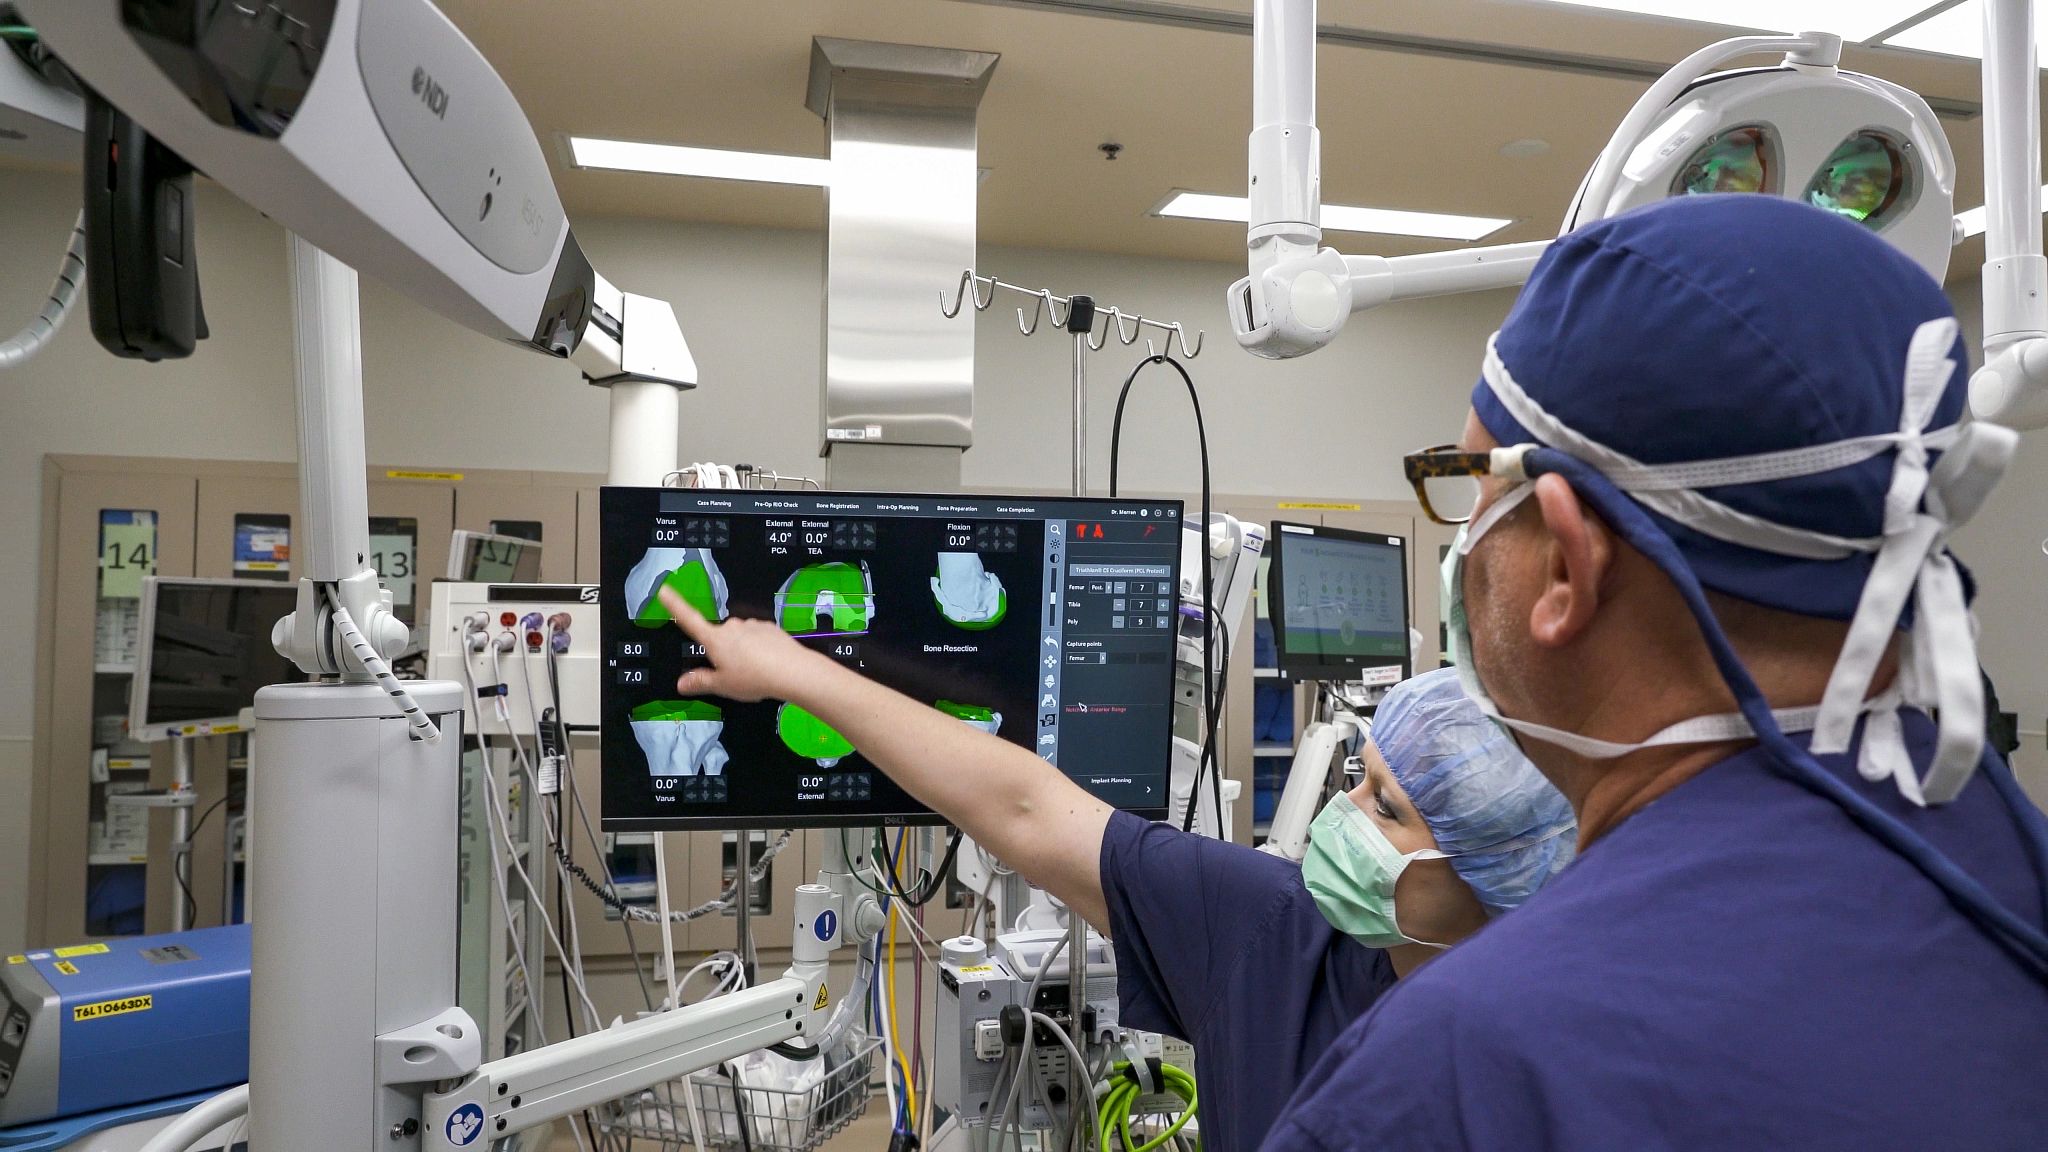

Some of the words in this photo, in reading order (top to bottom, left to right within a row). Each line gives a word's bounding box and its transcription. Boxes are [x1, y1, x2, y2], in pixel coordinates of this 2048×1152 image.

[765, 520, 794, 528] External
[801, 520, 829, 528] External
[947, 523, 971, 531] Flexion
[808, 547, 822, 555] TEA
[108, 542, 150, 570] 14
[372, 551, 409, 578] 13
[1139, 601, 1144, 609] 7
[1067, 618, 1079, 626] Poly
[1138, 618, 1143, 626] 9
[624, 645, 642, 655] 8.0
[689, 645, 706, 655] 1.0
[835, 645, 853, 655] 4.0
[624, 671, 642, 682] 7.0
[1091, 777, 1110, 785] Implant
[797, 792, 825, 800] External
